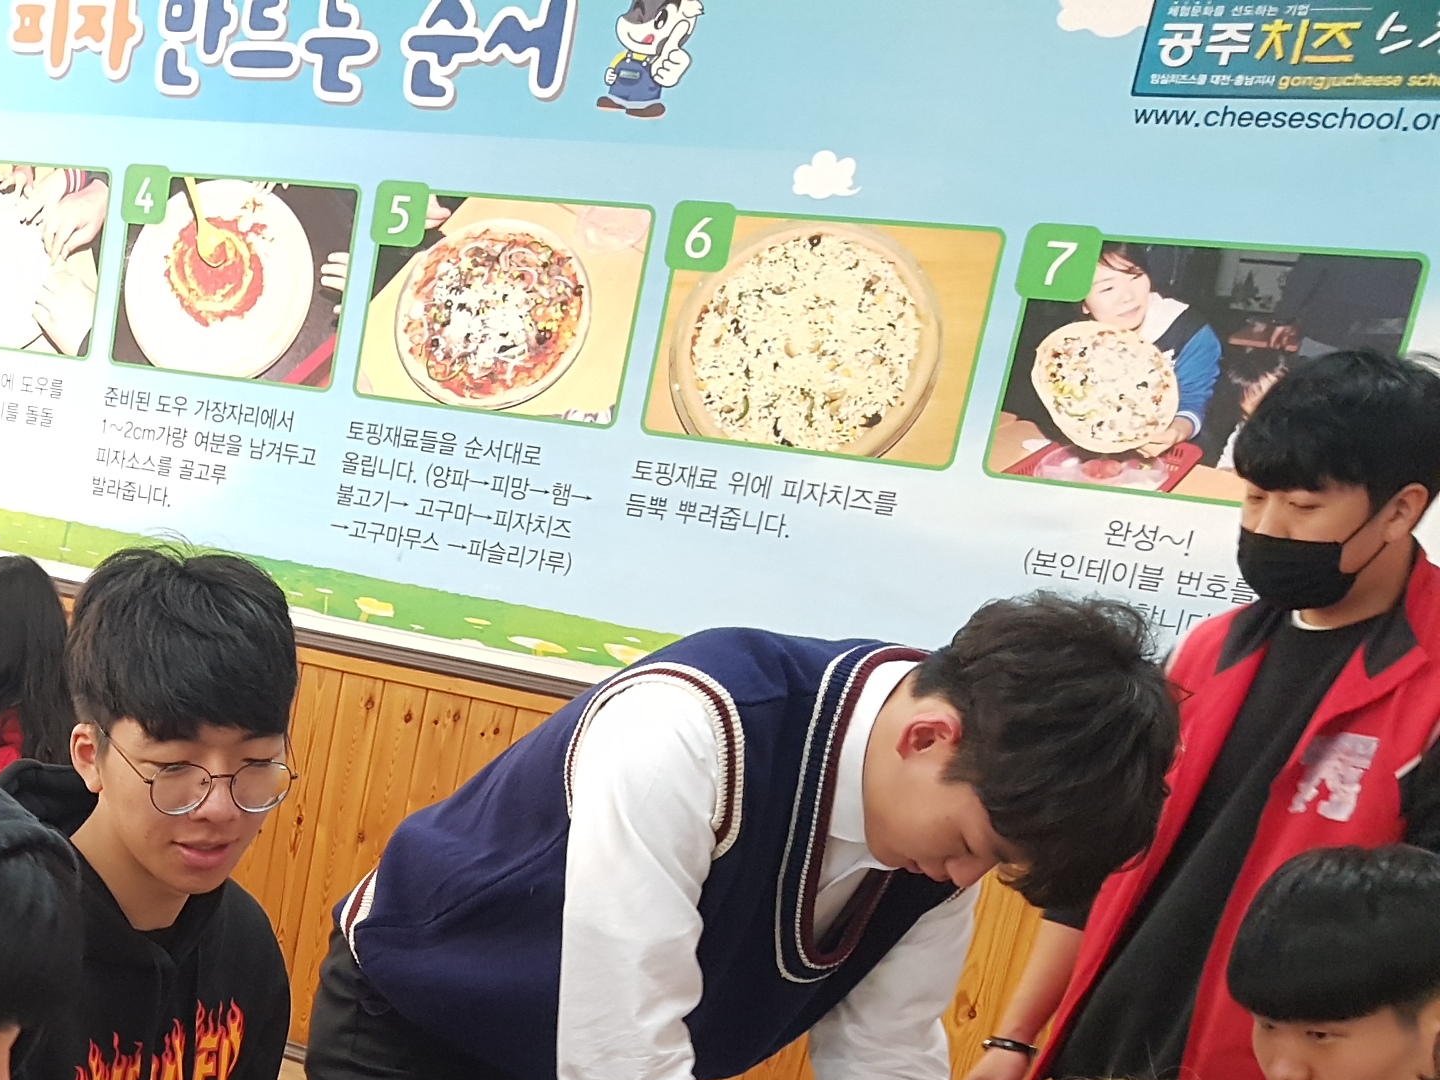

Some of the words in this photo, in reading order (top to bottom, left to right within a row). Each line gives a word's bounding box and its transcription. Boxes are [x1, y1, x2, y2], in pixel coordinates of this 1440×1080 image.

[1231, 5, 1279, 17] 선도하는
[1285, 4, 1310, 17] 기업
[11, 0, 140, 76] 피자
[159, 0, 373, 95] 만드는
[406, 0, 570, 100] 순서
[134, 176, 154, 214] 4
[387, 195, 412, 235] 5
[684, 216, 714, 259] 6
[1043, 240, 1079, 287] 7
[20, 375, 63, 399] 도우를
[25, 405, 54, 428] 돌돌
[103, 386, 152, 412] 준비된
[155, 394, 188, 417] 도우
[193, 399, 296, 432] 가장자리에서
[194, 430, 243, 457] 여분을
[249, 437, 317, 466] 남겨두고
[345, 420, 458, 457] 토핑재료들을
[463, 435, 542, 467] 순서대로
[95, 446, 173, 477] 피자소스를
[178, 458, 228, 485] 골고루
[340, 451, 417, 485] 올립니다.
[92, 475, 172, 508] 발라줍니다.
[631, 459, 718, 490] 토핑재료
[728, 470, 774, 500] 위에
[780, 479, 898, 517] 피자치즈를
[625, 493, 668, 521] 듬뿍
[675, 500, 790, 539] 뿌려줍니다.
[1104, 519, 1195, 557] 완성~!
[1023, 547, 1165, 593] (본인테이블
[1176, 570, 1259, 606] 번호를
